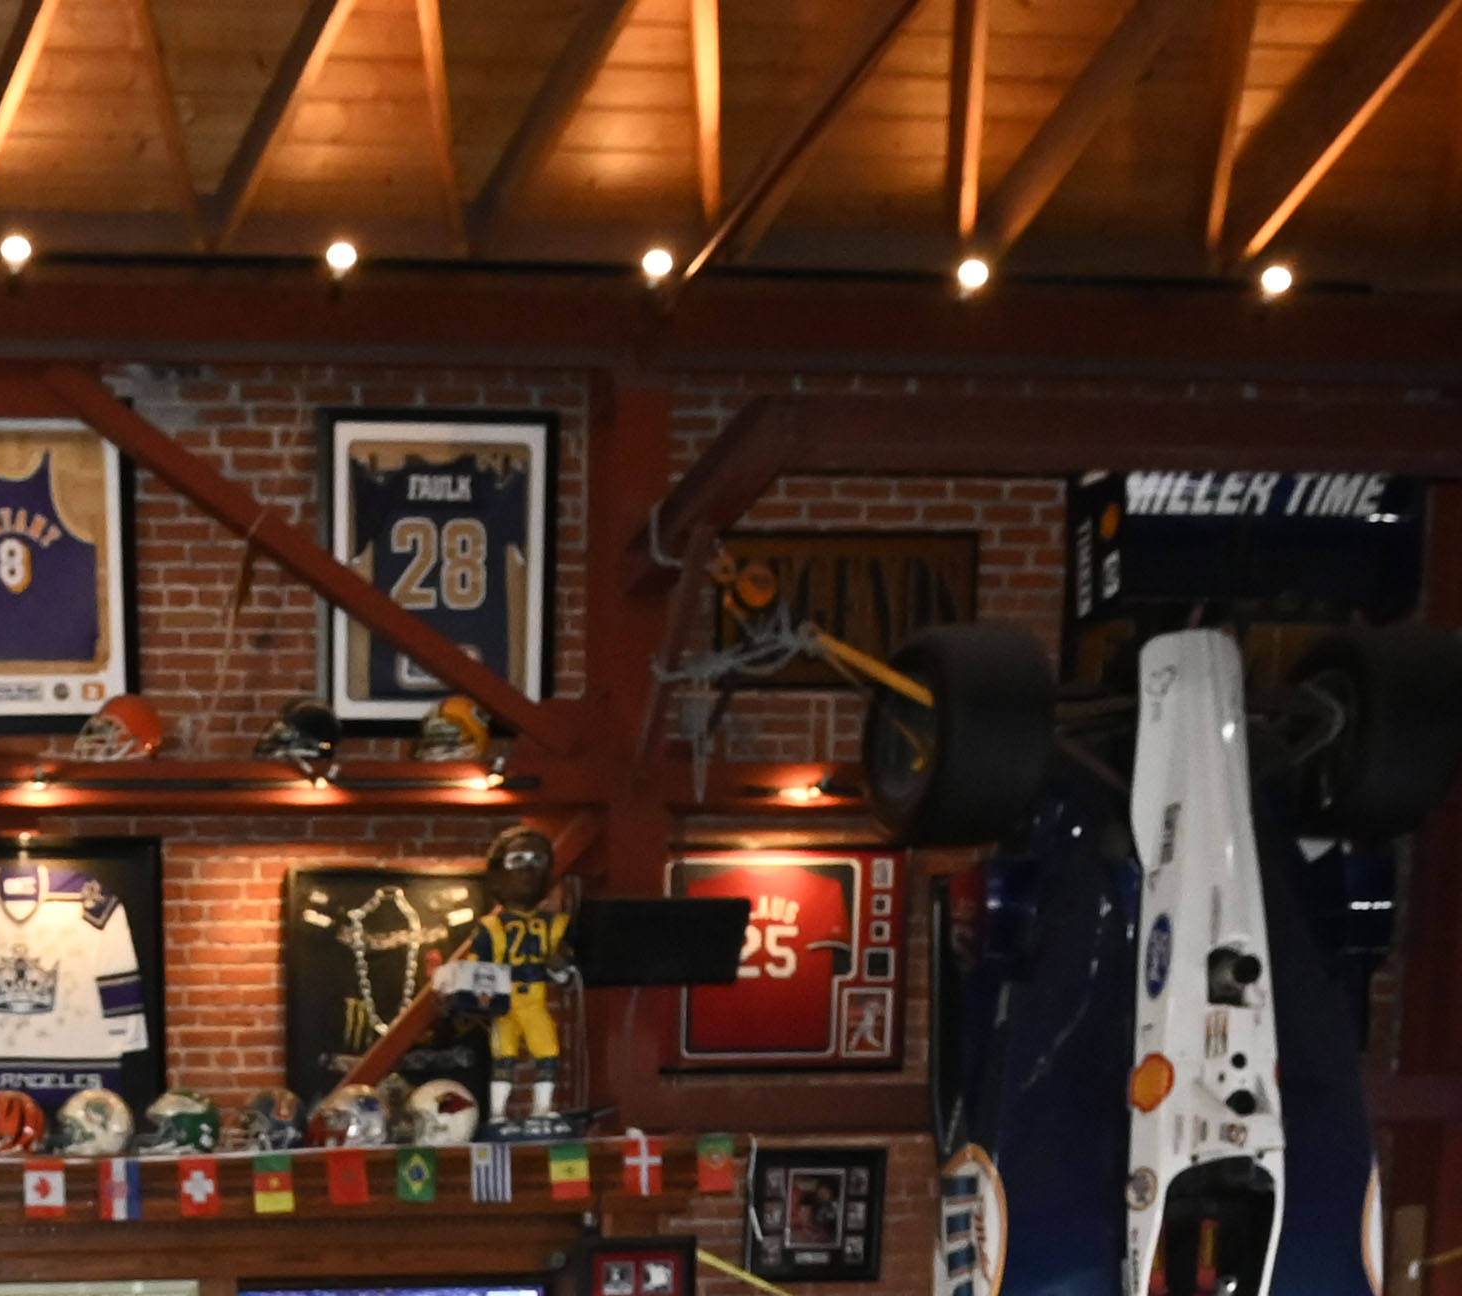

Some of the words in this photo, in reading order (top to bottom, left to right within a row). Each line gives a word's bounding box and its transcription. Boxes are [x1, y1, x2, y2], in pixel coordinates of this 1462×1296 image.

[1125, 470, 1280, 517] MILLER
[1282, 472, 1386, 518] TIME
[390, 517, 487, 609] 28
[509, 919, 549, 963] 29
[5, 1072, 103, 1091] ANGELES
